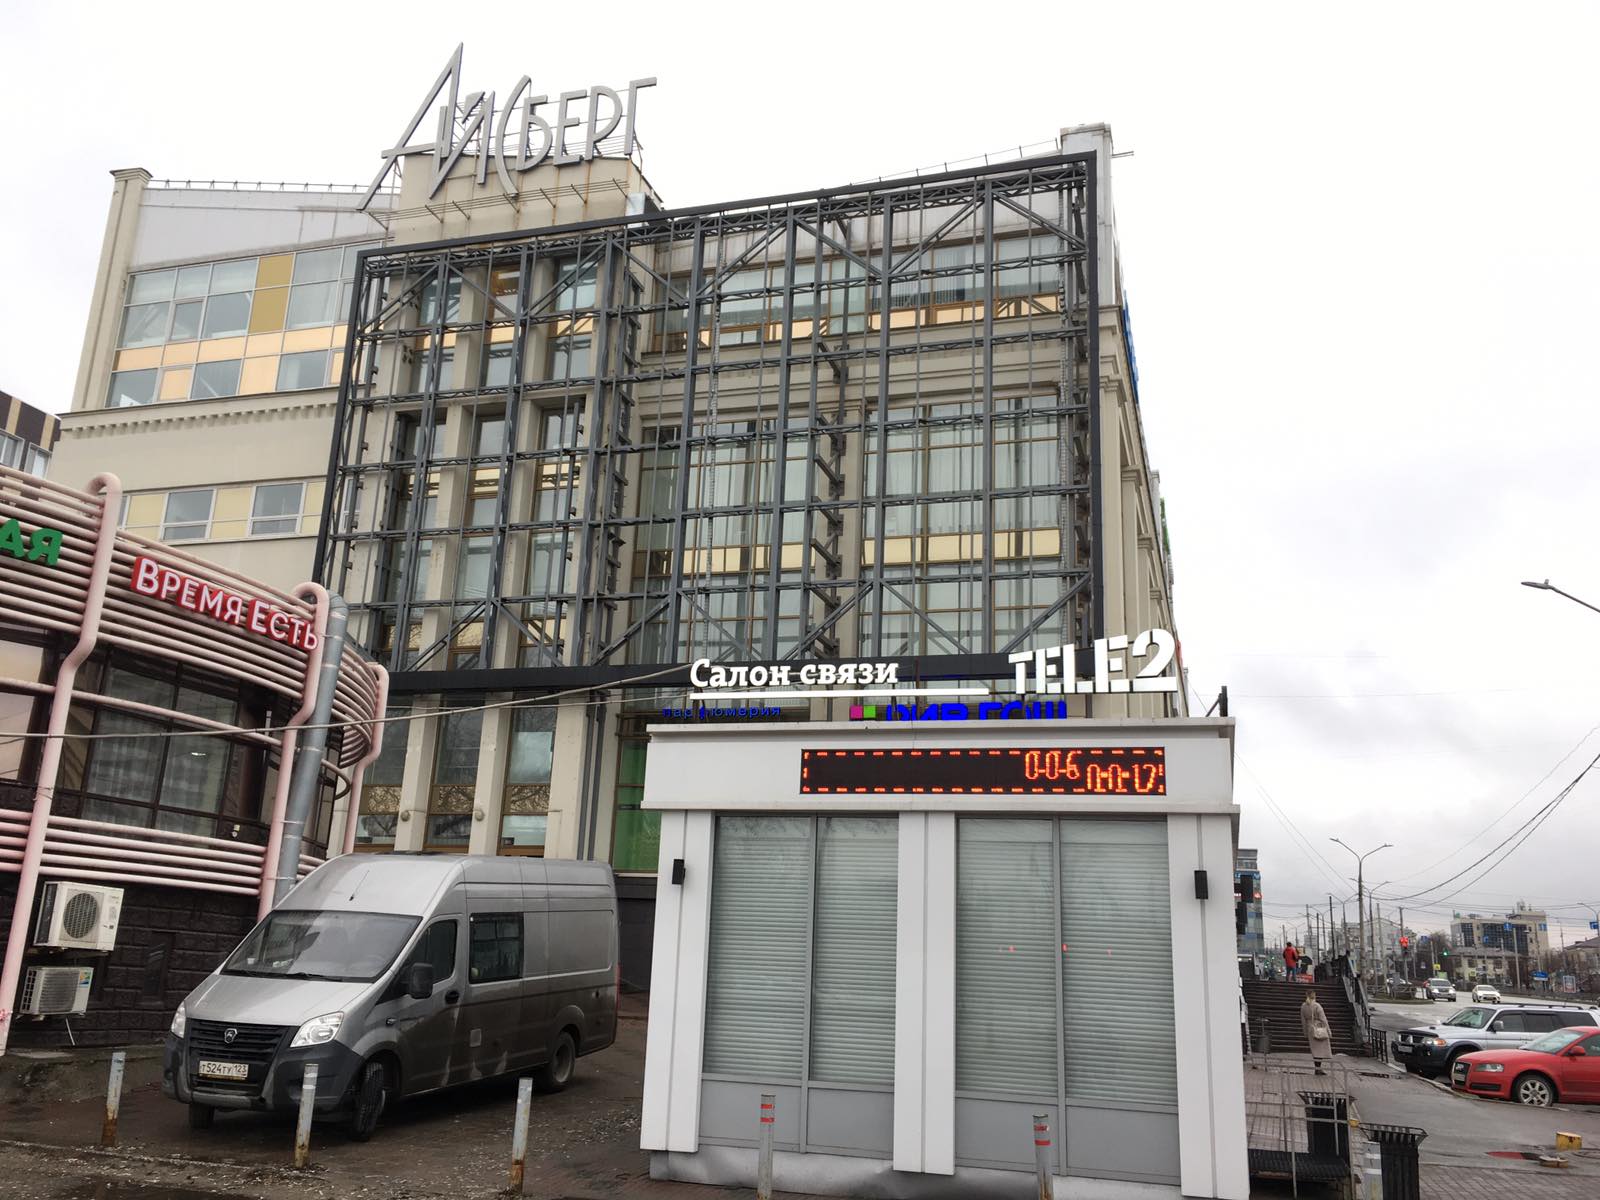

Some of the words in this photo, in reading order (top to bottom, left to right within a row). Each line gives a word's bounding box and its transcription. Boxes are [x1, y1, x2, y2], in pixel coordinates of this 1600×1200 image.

[690, 658, 791, 687] Салон
[800, 662, 899, 685] связи
[1008, 628, 1178, 694] TELE2
